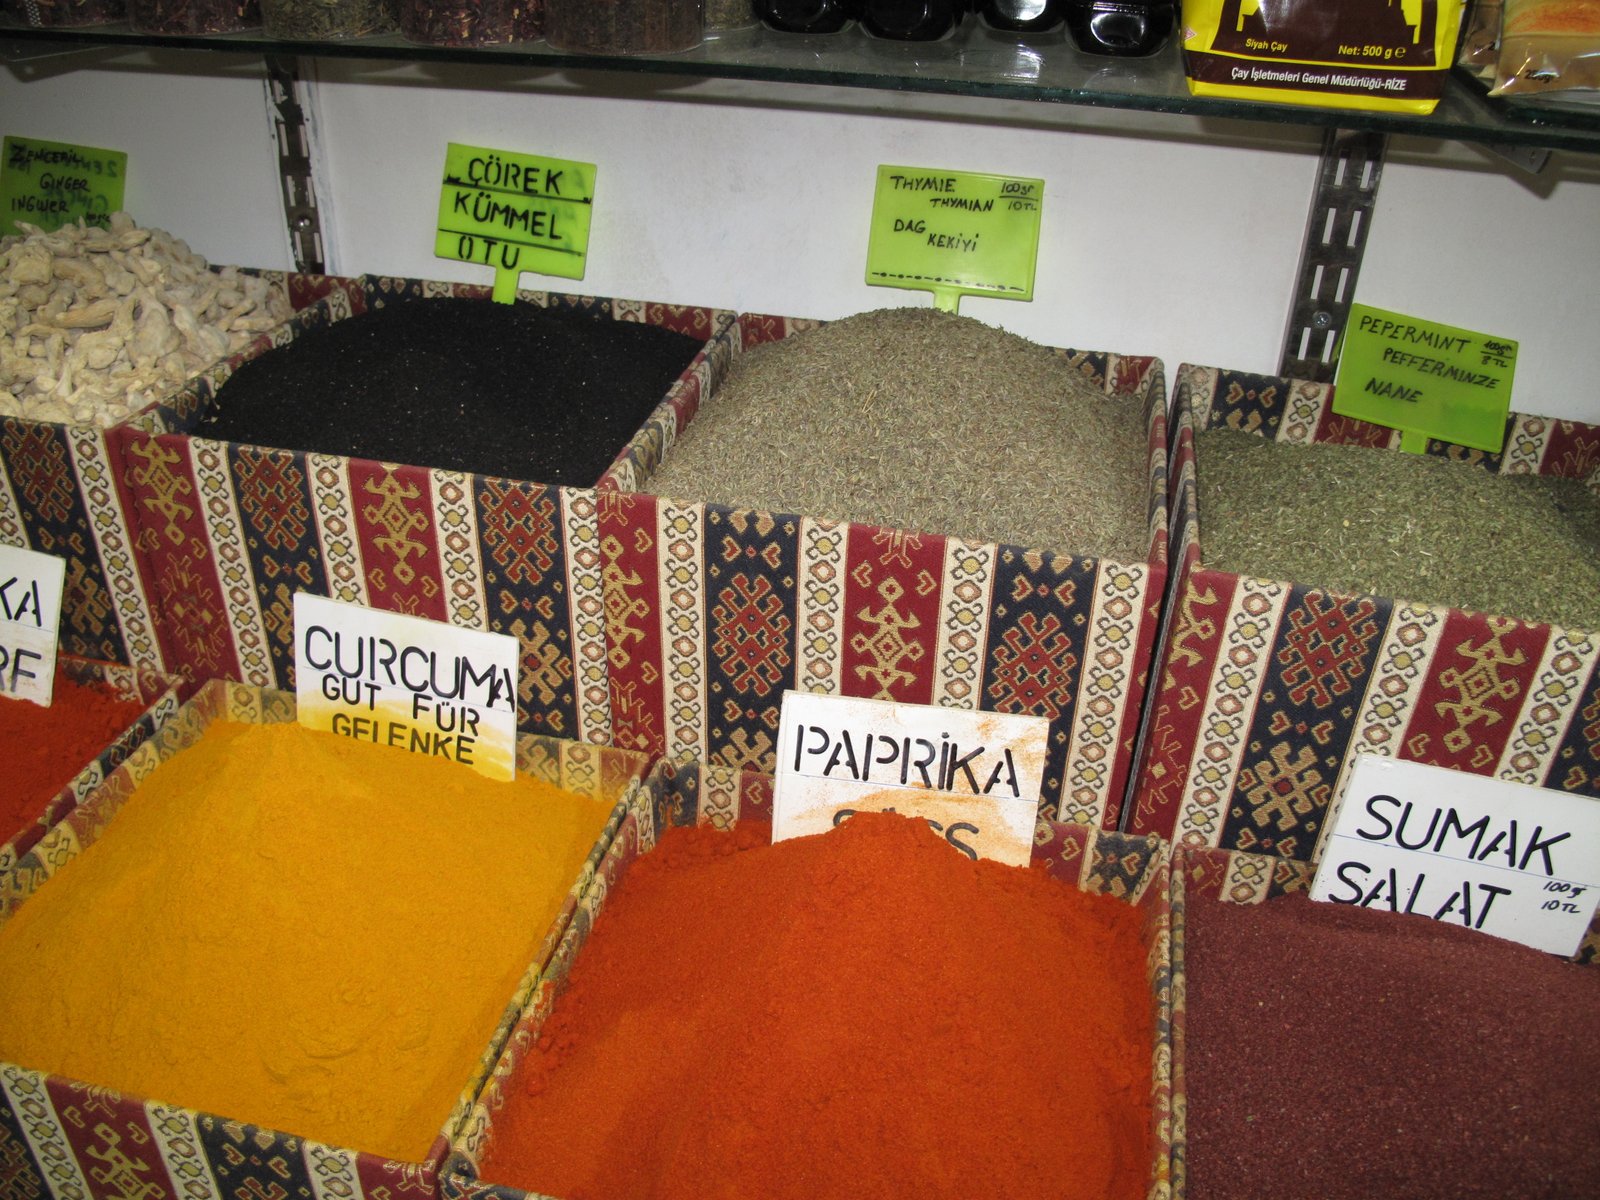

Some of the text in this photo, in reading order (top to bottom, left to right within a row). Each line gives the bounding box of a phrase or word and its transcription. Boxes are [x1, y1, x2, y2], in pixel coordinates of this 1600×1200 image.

[1245, 38, 1288, 53] Siyah Çay
[1338, 45, 1360, 55] Net:
[1362, 46, 1382, 56] 500
[1231, 67, 1250, 80] Çay
[1251, 67, 1300, 82] İşletmeleri
[1301, 72, 1329, 85] Genel
[40, 172, 91, 192] GINGER
[468, 154, 563, 195] ÇÖREK
[890, 176, 957, 193] THYMIE
[11, 196, 69, 213] INGWER
[454, 191, 562, 239] KÜMMEL
[930, 198, 995, 212] THYMIAN
[894, 219, 926, 233] DAG
[458, 235, 520, 269] OTU
[1359, 316, 1471, 352] PEPERMINT
[1383, 347, 1500, 389] PEFFERMINZE
[1364, 377, 1423, 403] NANE
[305, 625, 516, 713] CURCUMA
[322, 673, 480, 736] GUT FÜR
[1356, 794, 1571, 876] SUMAK
[1327, 861, 1512, 929] SALAT
